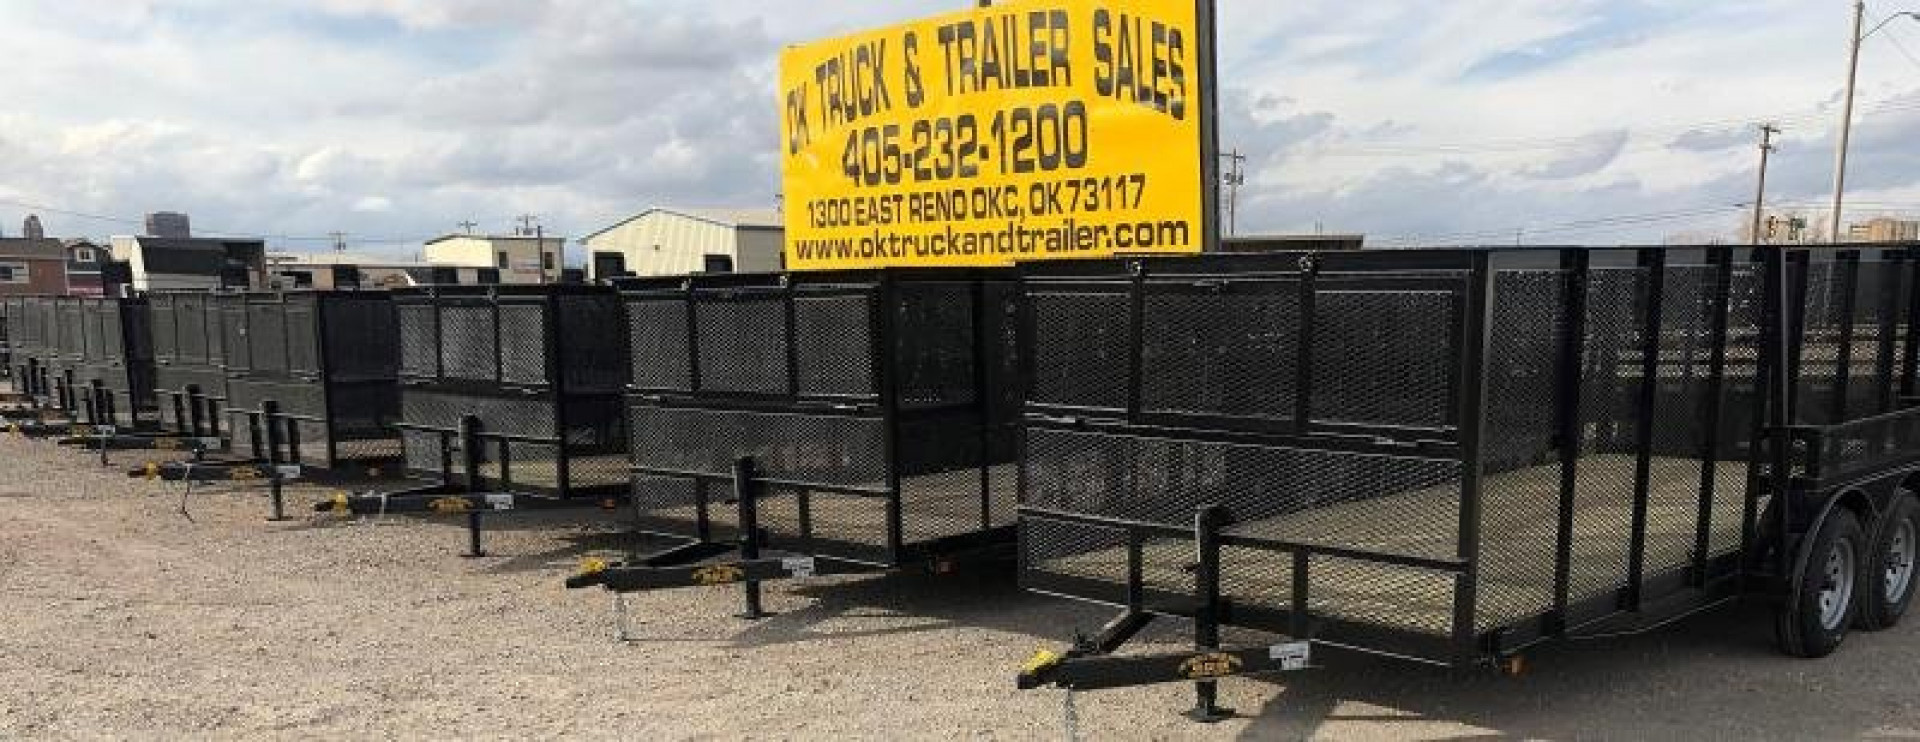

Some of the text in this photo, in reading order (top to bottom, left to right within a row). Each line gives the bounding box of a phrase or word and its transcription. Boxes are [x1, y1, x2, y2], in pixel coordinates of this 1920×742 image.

[785, 8, 1186, 155] OK TRUCK & TRAILER SALES
[842, 100, 1088, 188] 405-232-1200
[807, 174, 1146, 229] 1300 EAST RENO OKC, OK 73117
[795, 219, 1189, 261] www.oktruckandtrailer.com
